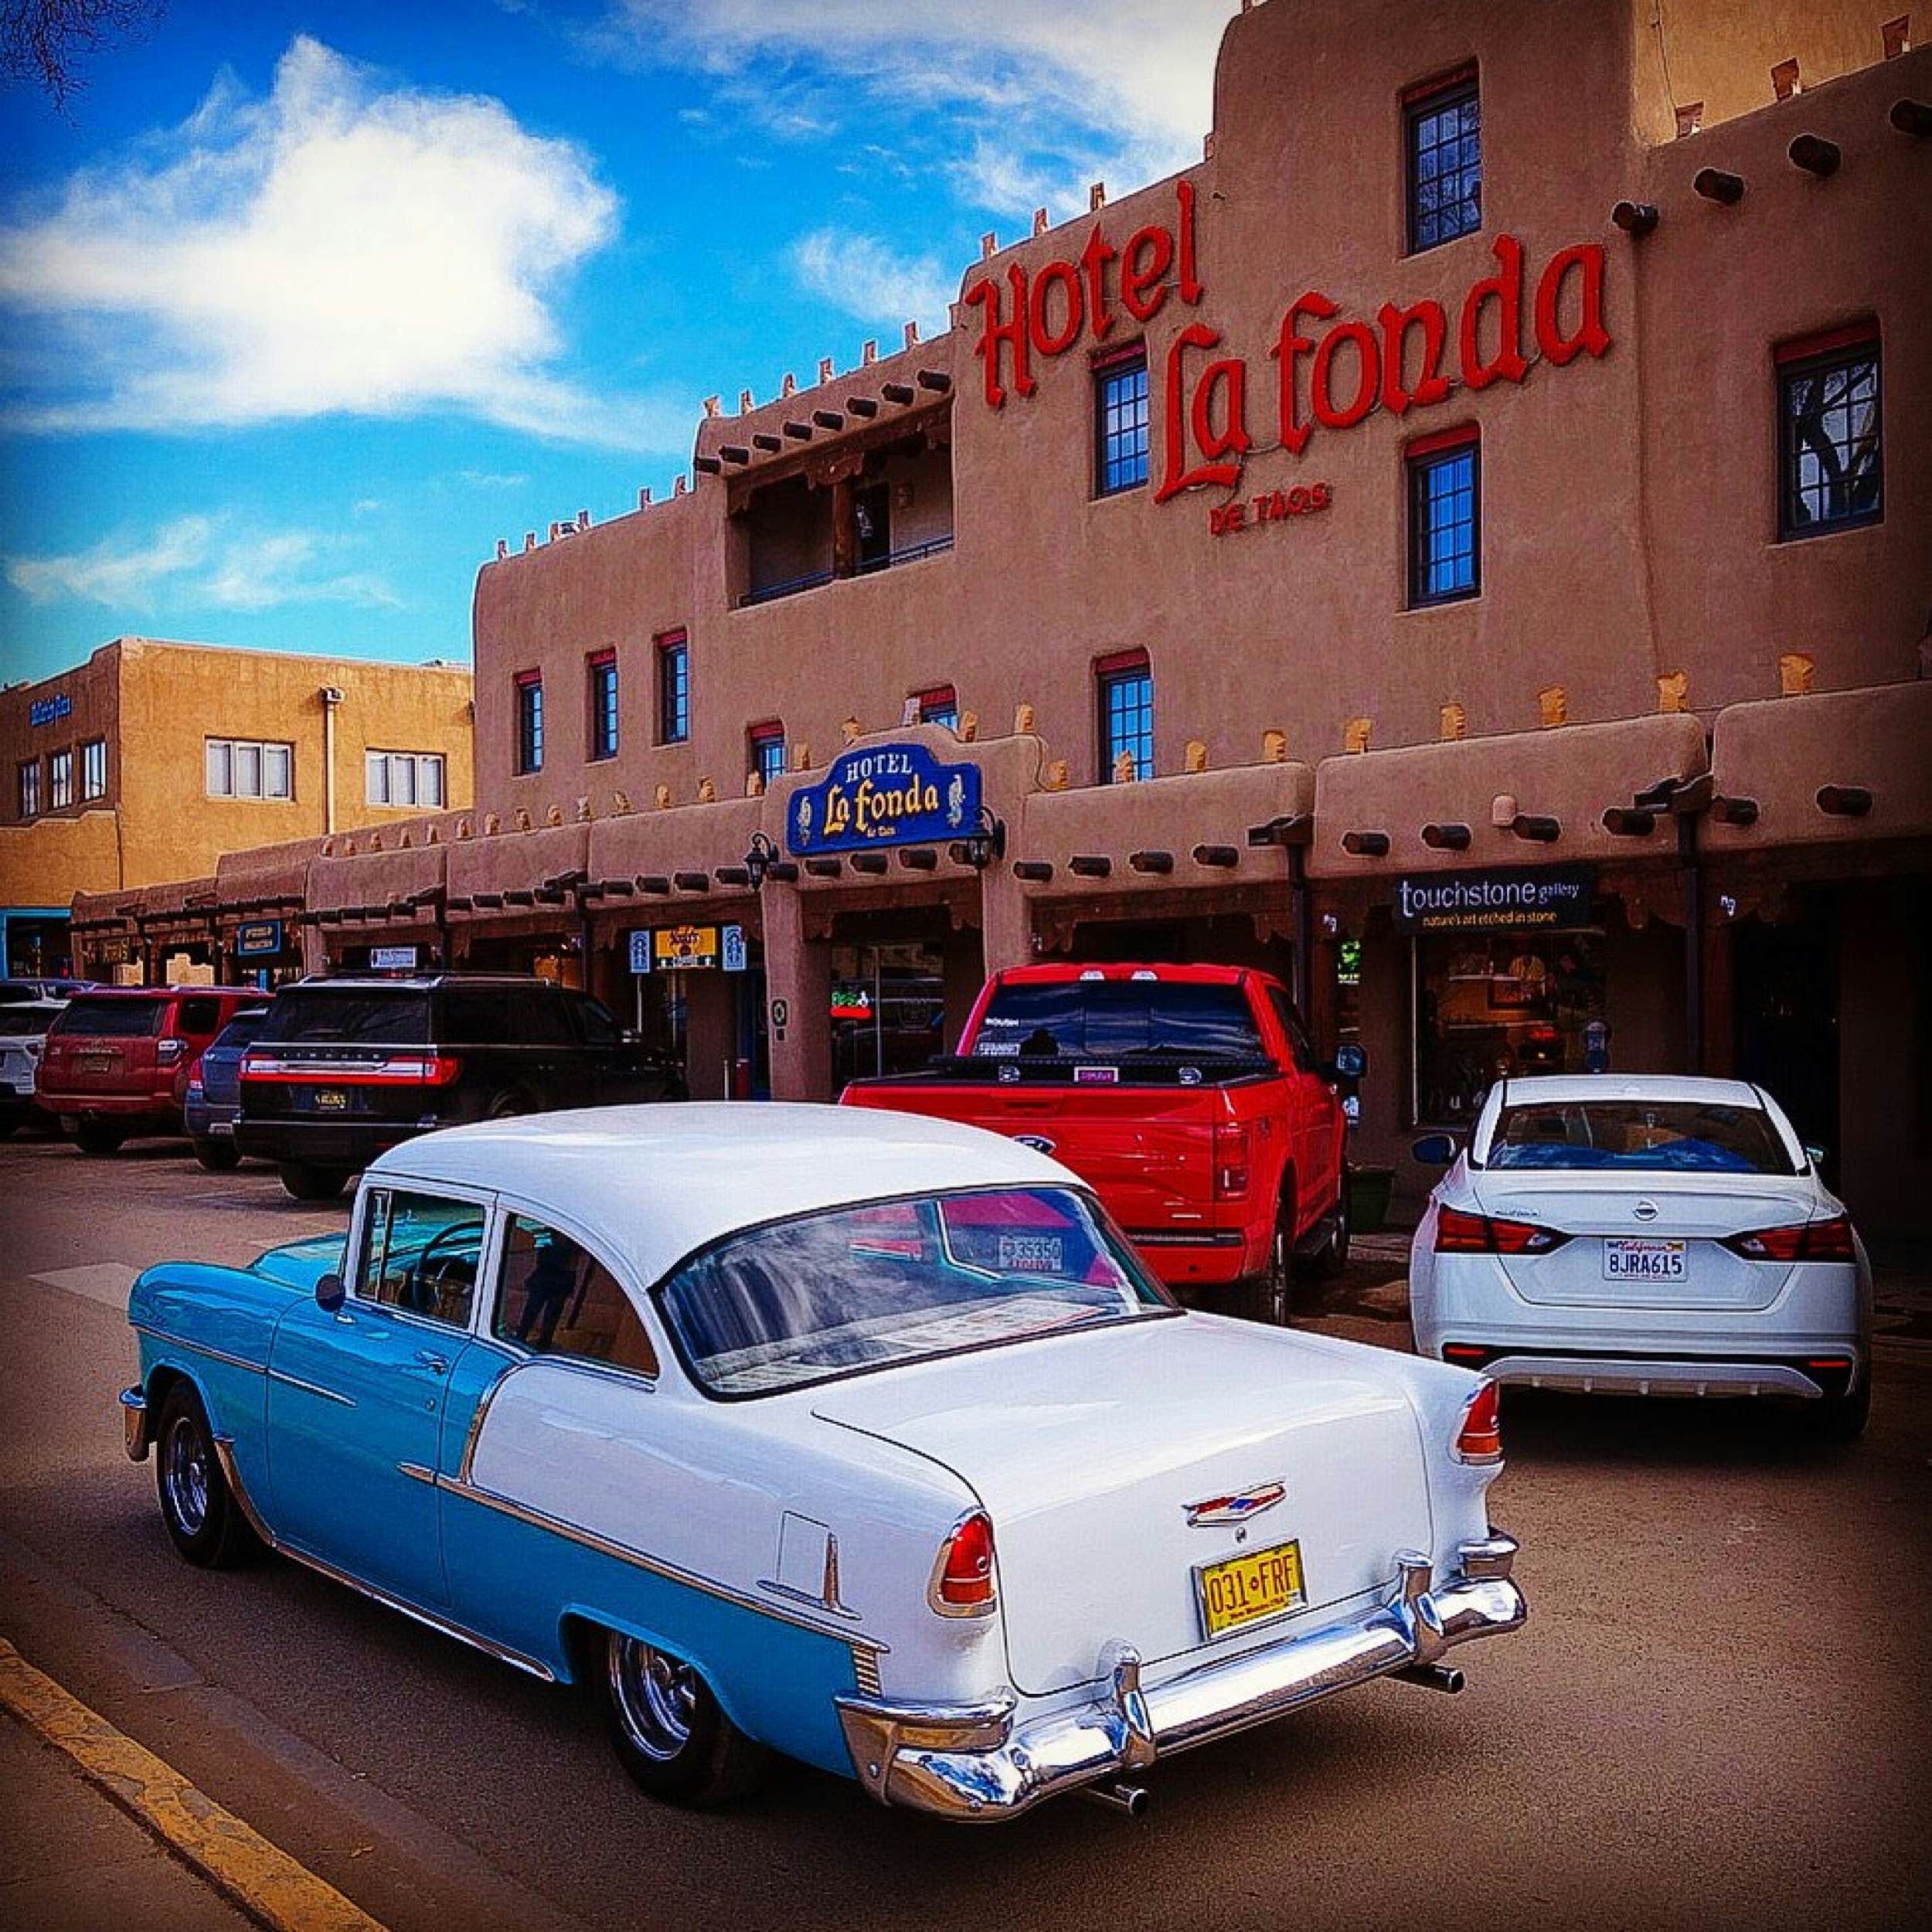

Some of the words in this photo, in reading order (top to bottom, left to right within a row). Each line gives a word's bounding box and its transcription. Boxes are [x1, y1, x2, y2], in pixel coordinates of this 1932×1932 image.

[966, 179, 1204, 407] Hotel
[1155, 325, 1251, 503] La
[1271, 233, 1612, 454] fonda
[1208, 503, 1245, 536] DE
[1251, 481, 1329, 522] TAOS
[846, 753, 913, 783] HOTEL
[824, 784, 850, 836] La
[854, 774, 939, 832] fonda
[1399, 879, 1536, 918] touchstone
[1538, 883, 1579, 905] gallery
[1462, 913, 1477, 926] art
[1478, 911, 1514, 925] etched
[1515, 913, 1526, 923] in
[1526, 911, 1558, 923] stone
[1610, 1254, 1682, 1275] 8JRA615
